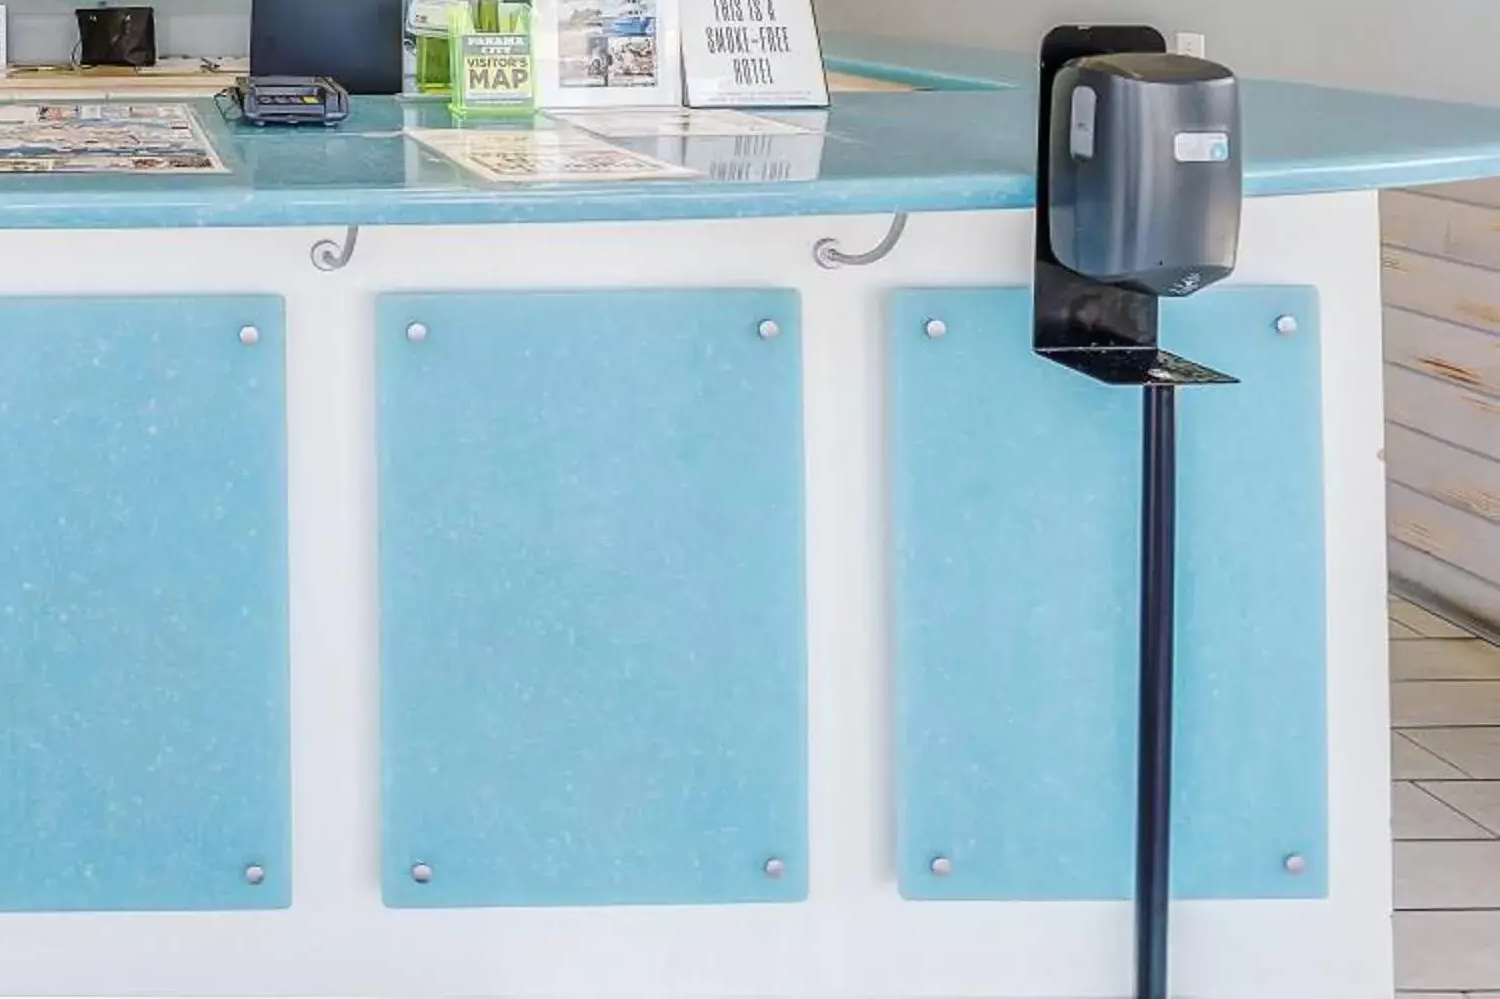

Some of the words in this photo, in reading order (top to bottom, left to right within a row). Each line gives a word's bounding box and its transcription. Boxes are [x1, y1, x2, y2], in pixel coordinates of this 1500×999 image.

[467, 36, 524, 45] PANAMA
[706, 26, 791, 53] SMOKE-FREE
[467, 57, 528, 68] VISITOR'S
[733, 58, 774, 85] HOTEL
[469, 68, 528, 89] MAP
